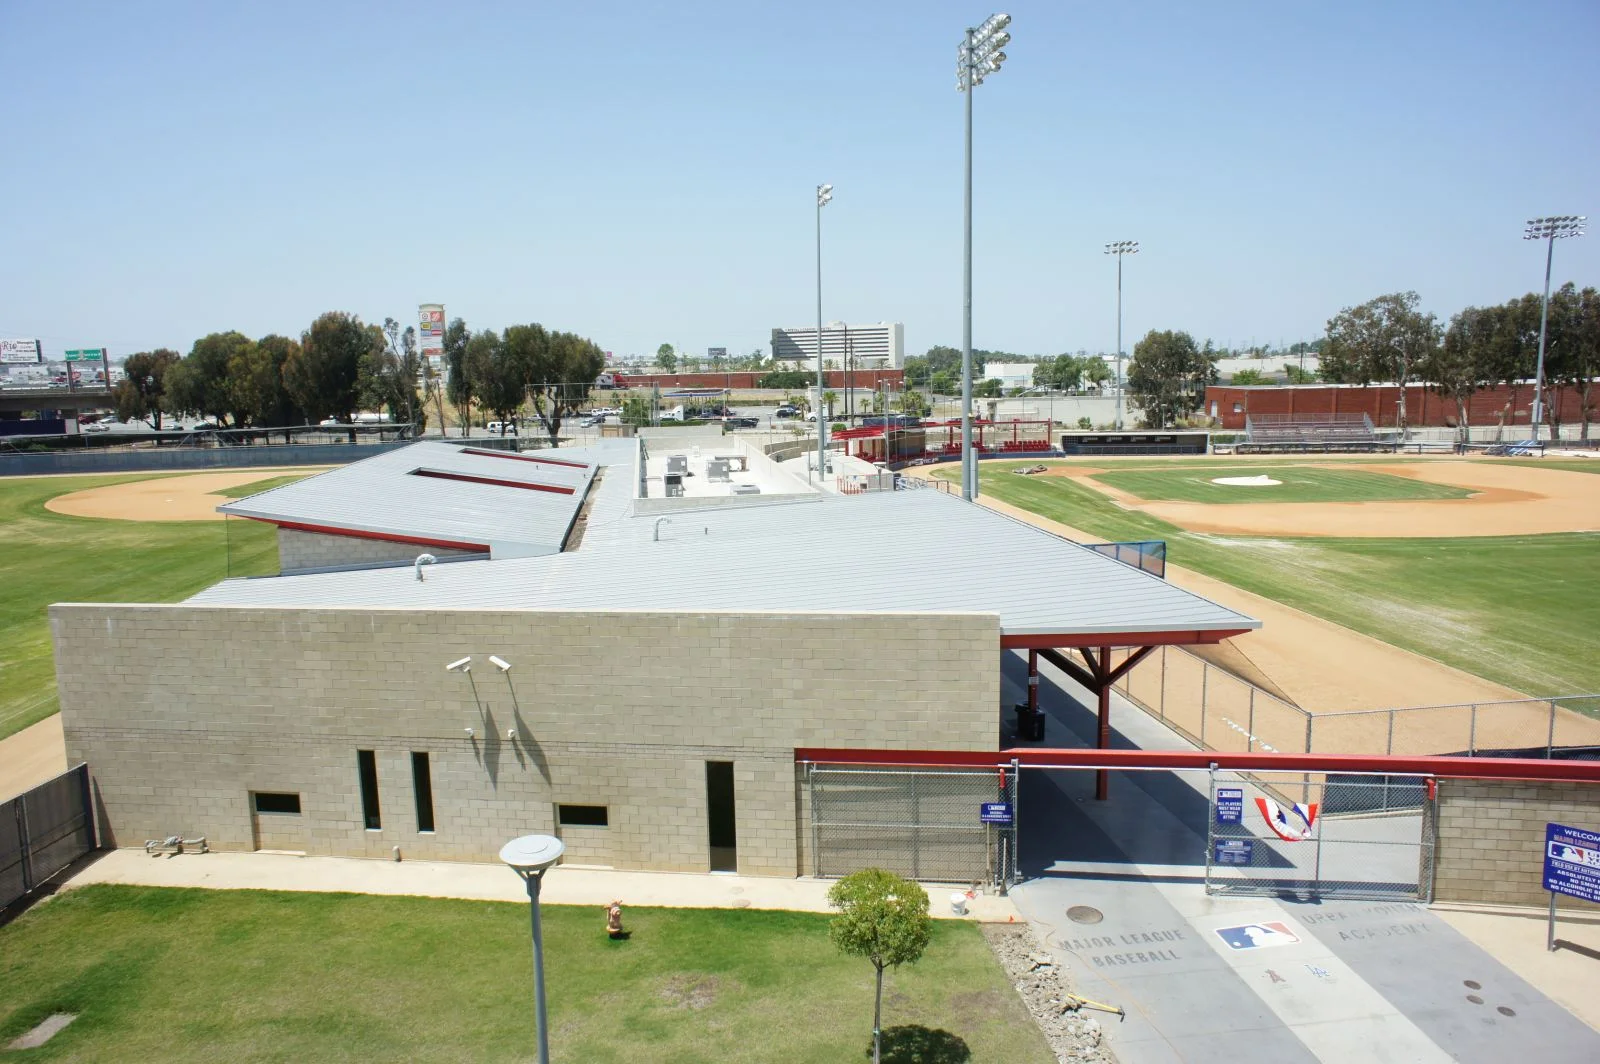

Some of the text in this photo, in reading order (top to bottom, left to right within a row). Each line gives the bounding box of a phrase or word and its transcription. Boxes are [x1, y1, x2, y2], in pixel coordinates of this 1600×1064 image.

[1557, 870, 1596, 882] ABSOLUTELY
[1559, 881, 1593, 893] ALCOHOLIC
[1561, 887, 1592, 898] FOOTBALL
[1058, 930, 1186, 950] MAJOR LEAGUE
[1092, 950, 1182, 967] BASEBALL
